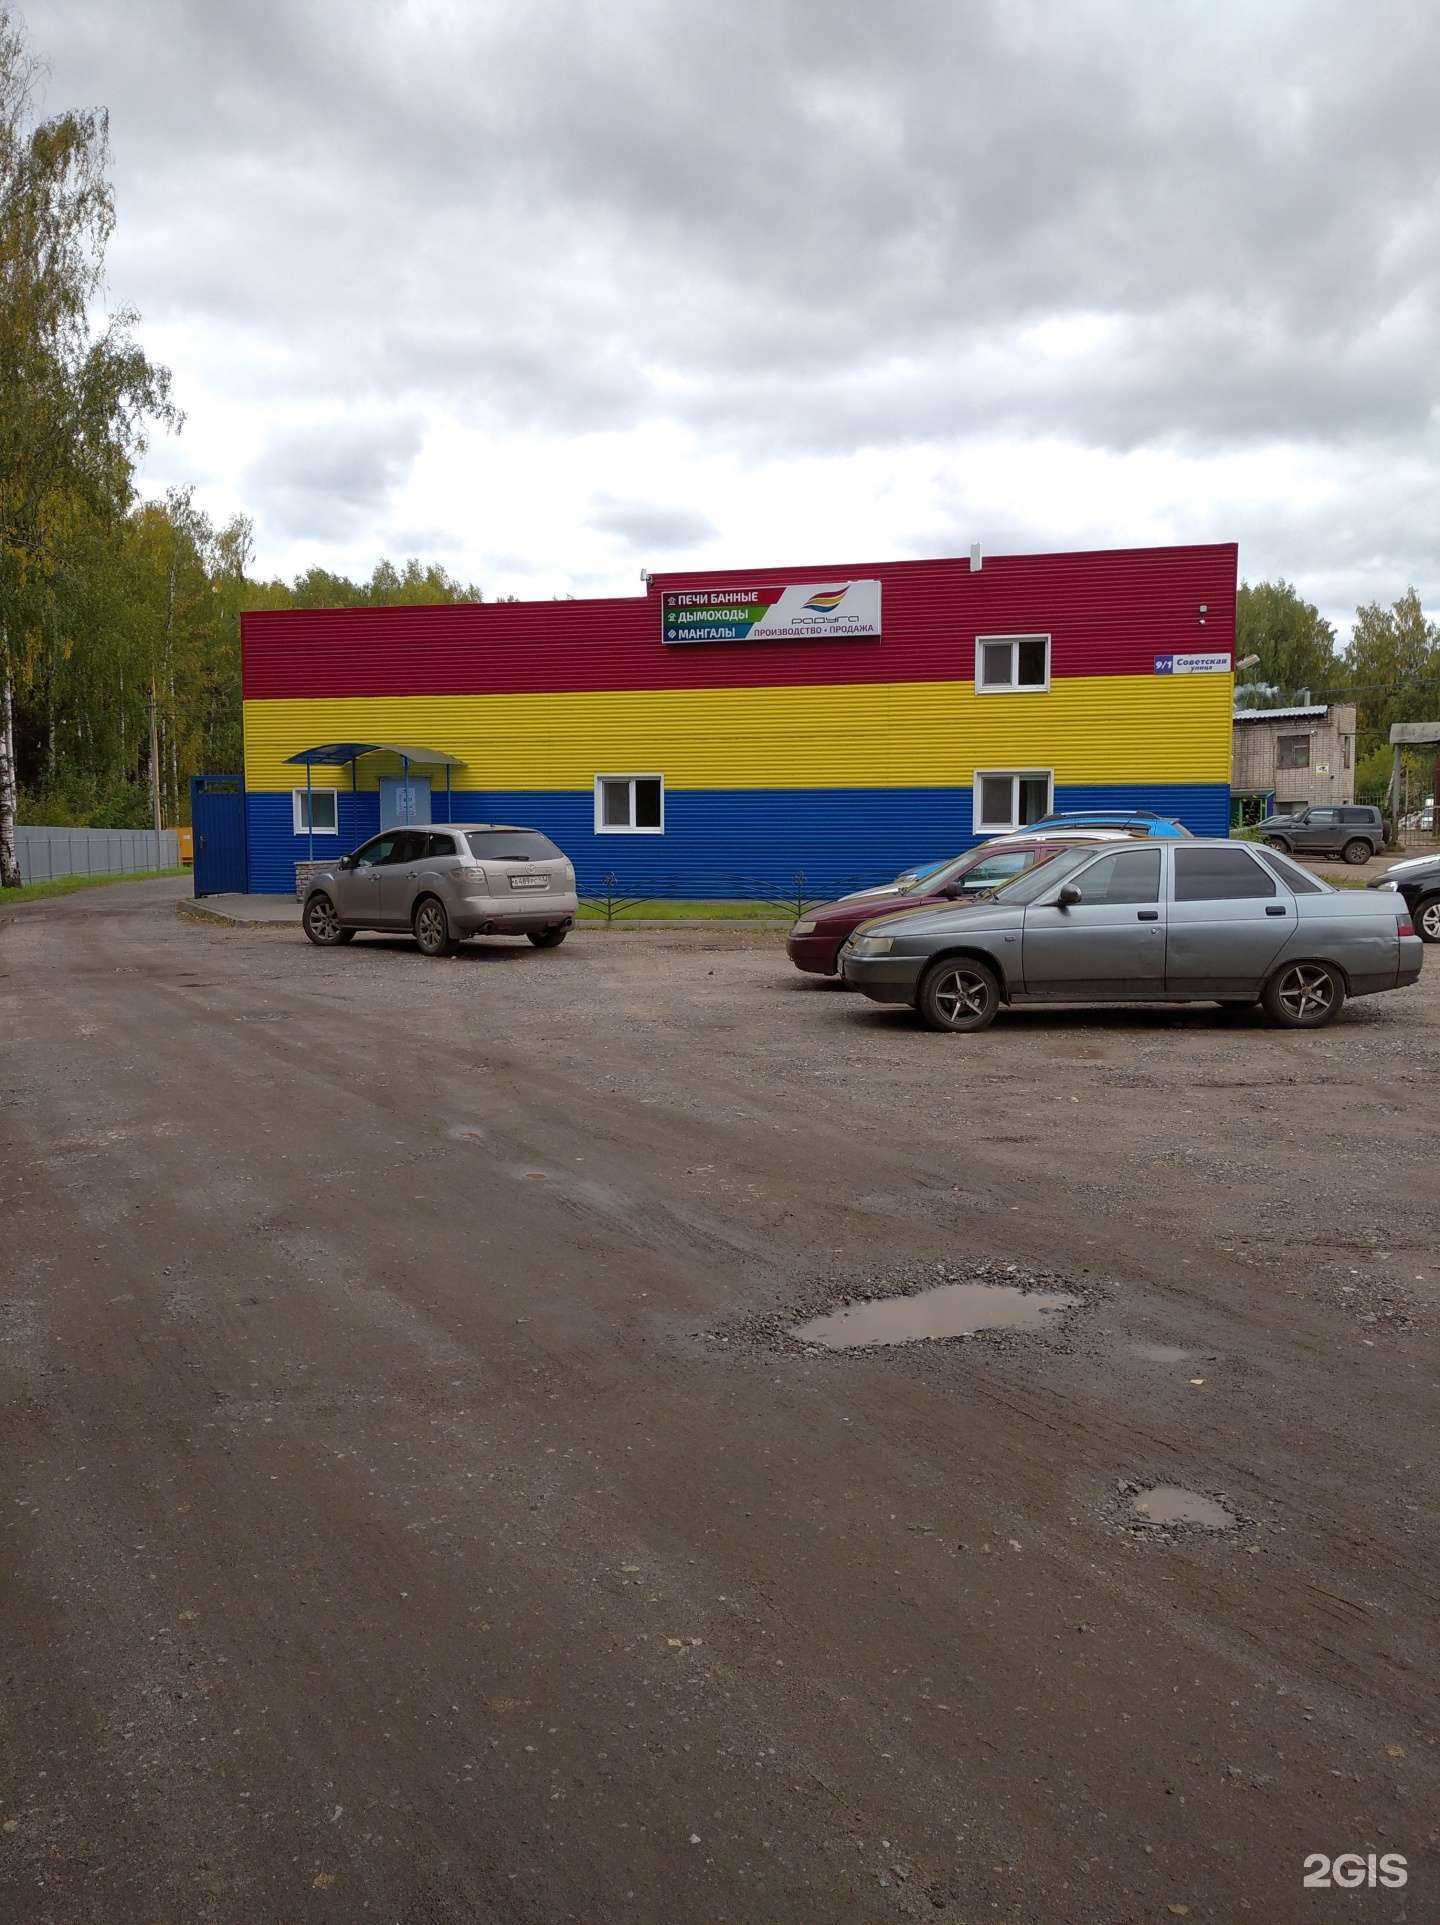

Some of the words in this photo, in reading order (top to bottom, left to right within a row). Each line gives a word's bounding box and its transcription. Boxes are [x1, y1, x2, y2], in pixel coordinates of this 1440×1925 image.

[678, 595, 708, 605] ПЕЧИ
[710, 592, 759, 604] БАННЫЕ
[677, 609, 749, 623] ДЫМОХОДЫ
[678, 628, 736, 639] МАНГАЛЫ
[754, 627, 822, 637] ПРОИЗВОДСТВО
[829, 624, 874, 634] ПРОДАЖА
